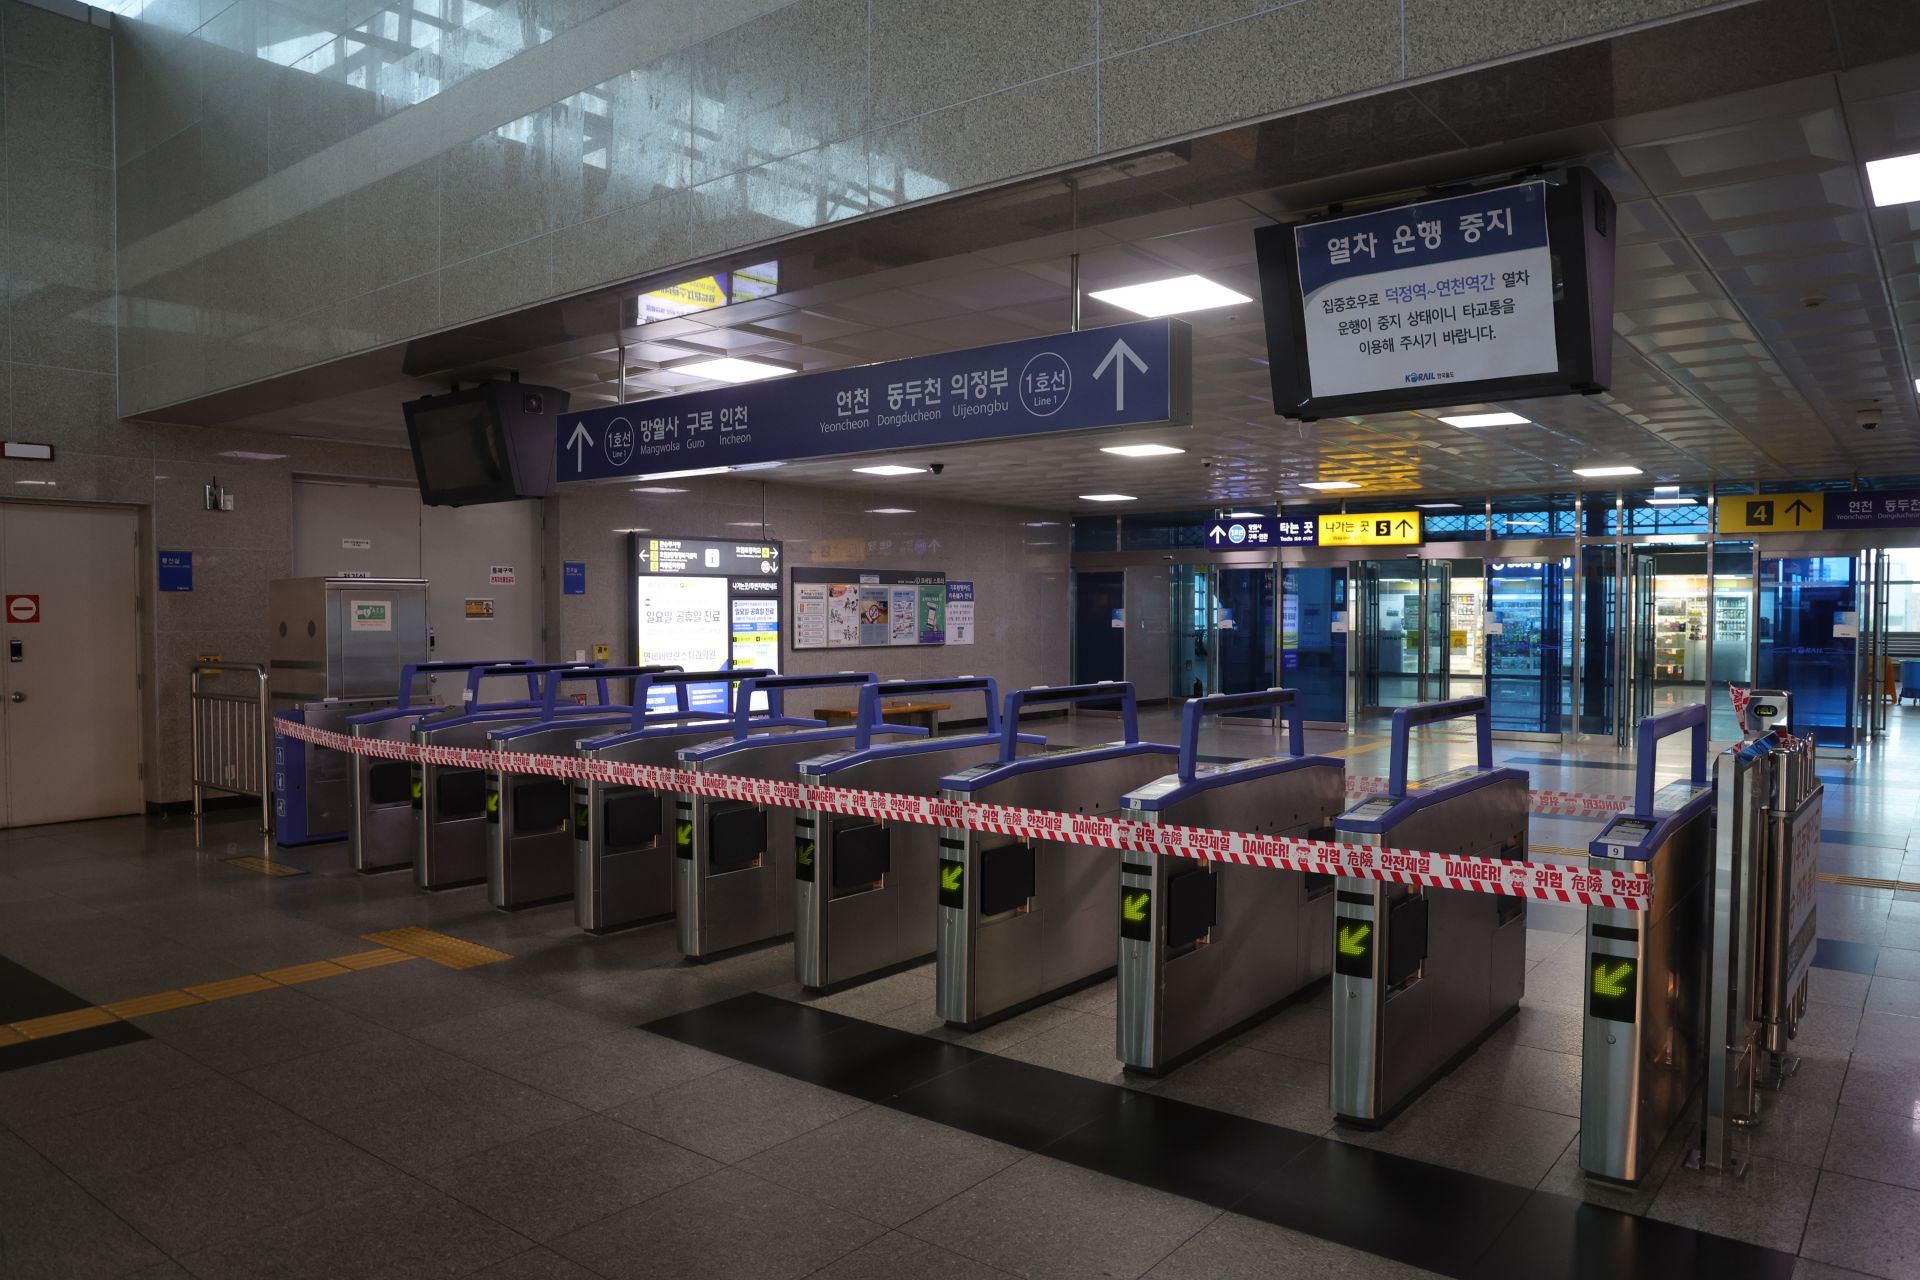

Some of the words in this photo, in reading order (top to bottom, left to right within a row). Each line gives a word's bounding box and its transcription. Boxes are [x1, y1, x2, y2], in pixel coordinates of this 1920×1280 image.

[1327, 231, 1378, 266] 열차
[1392, 218, 1442, 255] 운행
[1458, 206, 1514, 243] 중지
[1321, 292, 1380, 315] 집중호우로
[1385, 272, 1496, 306] 덕정역~연천역간
[1501, 269, 1531, 289] 열차
[1337, 317, 1372, 336] 운행이
[1377, 313, 1402, 333] 중지
[1406, 305, 1457, 327] 상태이니
[1462, 297, 1517, 319] 타교통을
[1358, 336, 1396, 357] 이용해
[1399, 332, 1438, 352] 주시기
[1442, 324, 1497, 346] 바랍니다.
[1025, 368, 1066, 395] 1호선
[1404, 372, 1436, 384] KORAIL
[836, 387, 870, 418] 연천
[887, 376, 942, 411] 동두천
[950, 367, 1009, 400] 의정부
[1034, 396, 1052, 407] Line
[1053, 395, 1058, 405] 1
[640, 415, 680, 443] 망월사
[686, 410, 713, 437] 구로
[719, 405, 748, 432] 인천
[819, 417, 870, 434] Yeoncheon
[877, 408, 942, 428] Dongducheon
[952, 399, 1009, 421] Uijeongbu
[607, 431, 631, 449] 1호선
[640, 441, 681, 456] Mangwolsa
[686, 438, 705, 450] Guro
[719, 432, 752, 446] Incheon
[612, 450, 623, 459] Line
[1752, 505, 1768, 522] 4
[1848, 500, 1873, 513] 연천
[1884, 499, 1920, 513] 동두천
[1836, 512, 1873, 521] Yeoncheon
[1279, 522, 1300, 535] 타는
[1303, 521, 1314, 534] 곳
[1325, 521, 1355, 533] 나가는
[1360, 521, 1370, 532] 곳
[1379, 522, 1388, 534] 5
[646, 611, 673, 624] 일요일
[676, 611, 702, 624] 공휴일
[704, 610, 721, 623] 진료
[612, 765, 635, 778] DANGER!
[674, 773, 697, 786] 안전제일
[702, 776, 728, 790] DANGER!
[741, 781, 754, 794] 위험
[773, 784, 800, 800] 안전제일
[806, 789, 836, 804] DANGER!
[852, 794, 867, 809] 위험
[870, 797, 887, 810] 危險
[889, 797, 921, 814] 안전제일
[928, 802, 963, 819] DANGER!
[981, 809, 999, 824] 위험
[1003, 811, 1022, 827] 危險
[1026, 813, 1063, 831] 안전제일
[1072, 819, 1113, 838] DANGER!
[1135, 826, 1155, 843] 위험
[1160, 829, 1183, 847] 危險
[1188, 831, 1231, 851] 안전제일
[1242, 838, 1290, 859] DANGER!
[1317, 847, 1341, 865] 위험
[1346, 850, 1374, 869] 危險
[1380, 851, 1431, 875] 안전제일
[1445, 859, 1502, 883] DANGER!
[1534, 869, 1563, 890] 위험
[1570, 872, 1603, 894] 危險
[1612, 847, 1619, 856] 9
